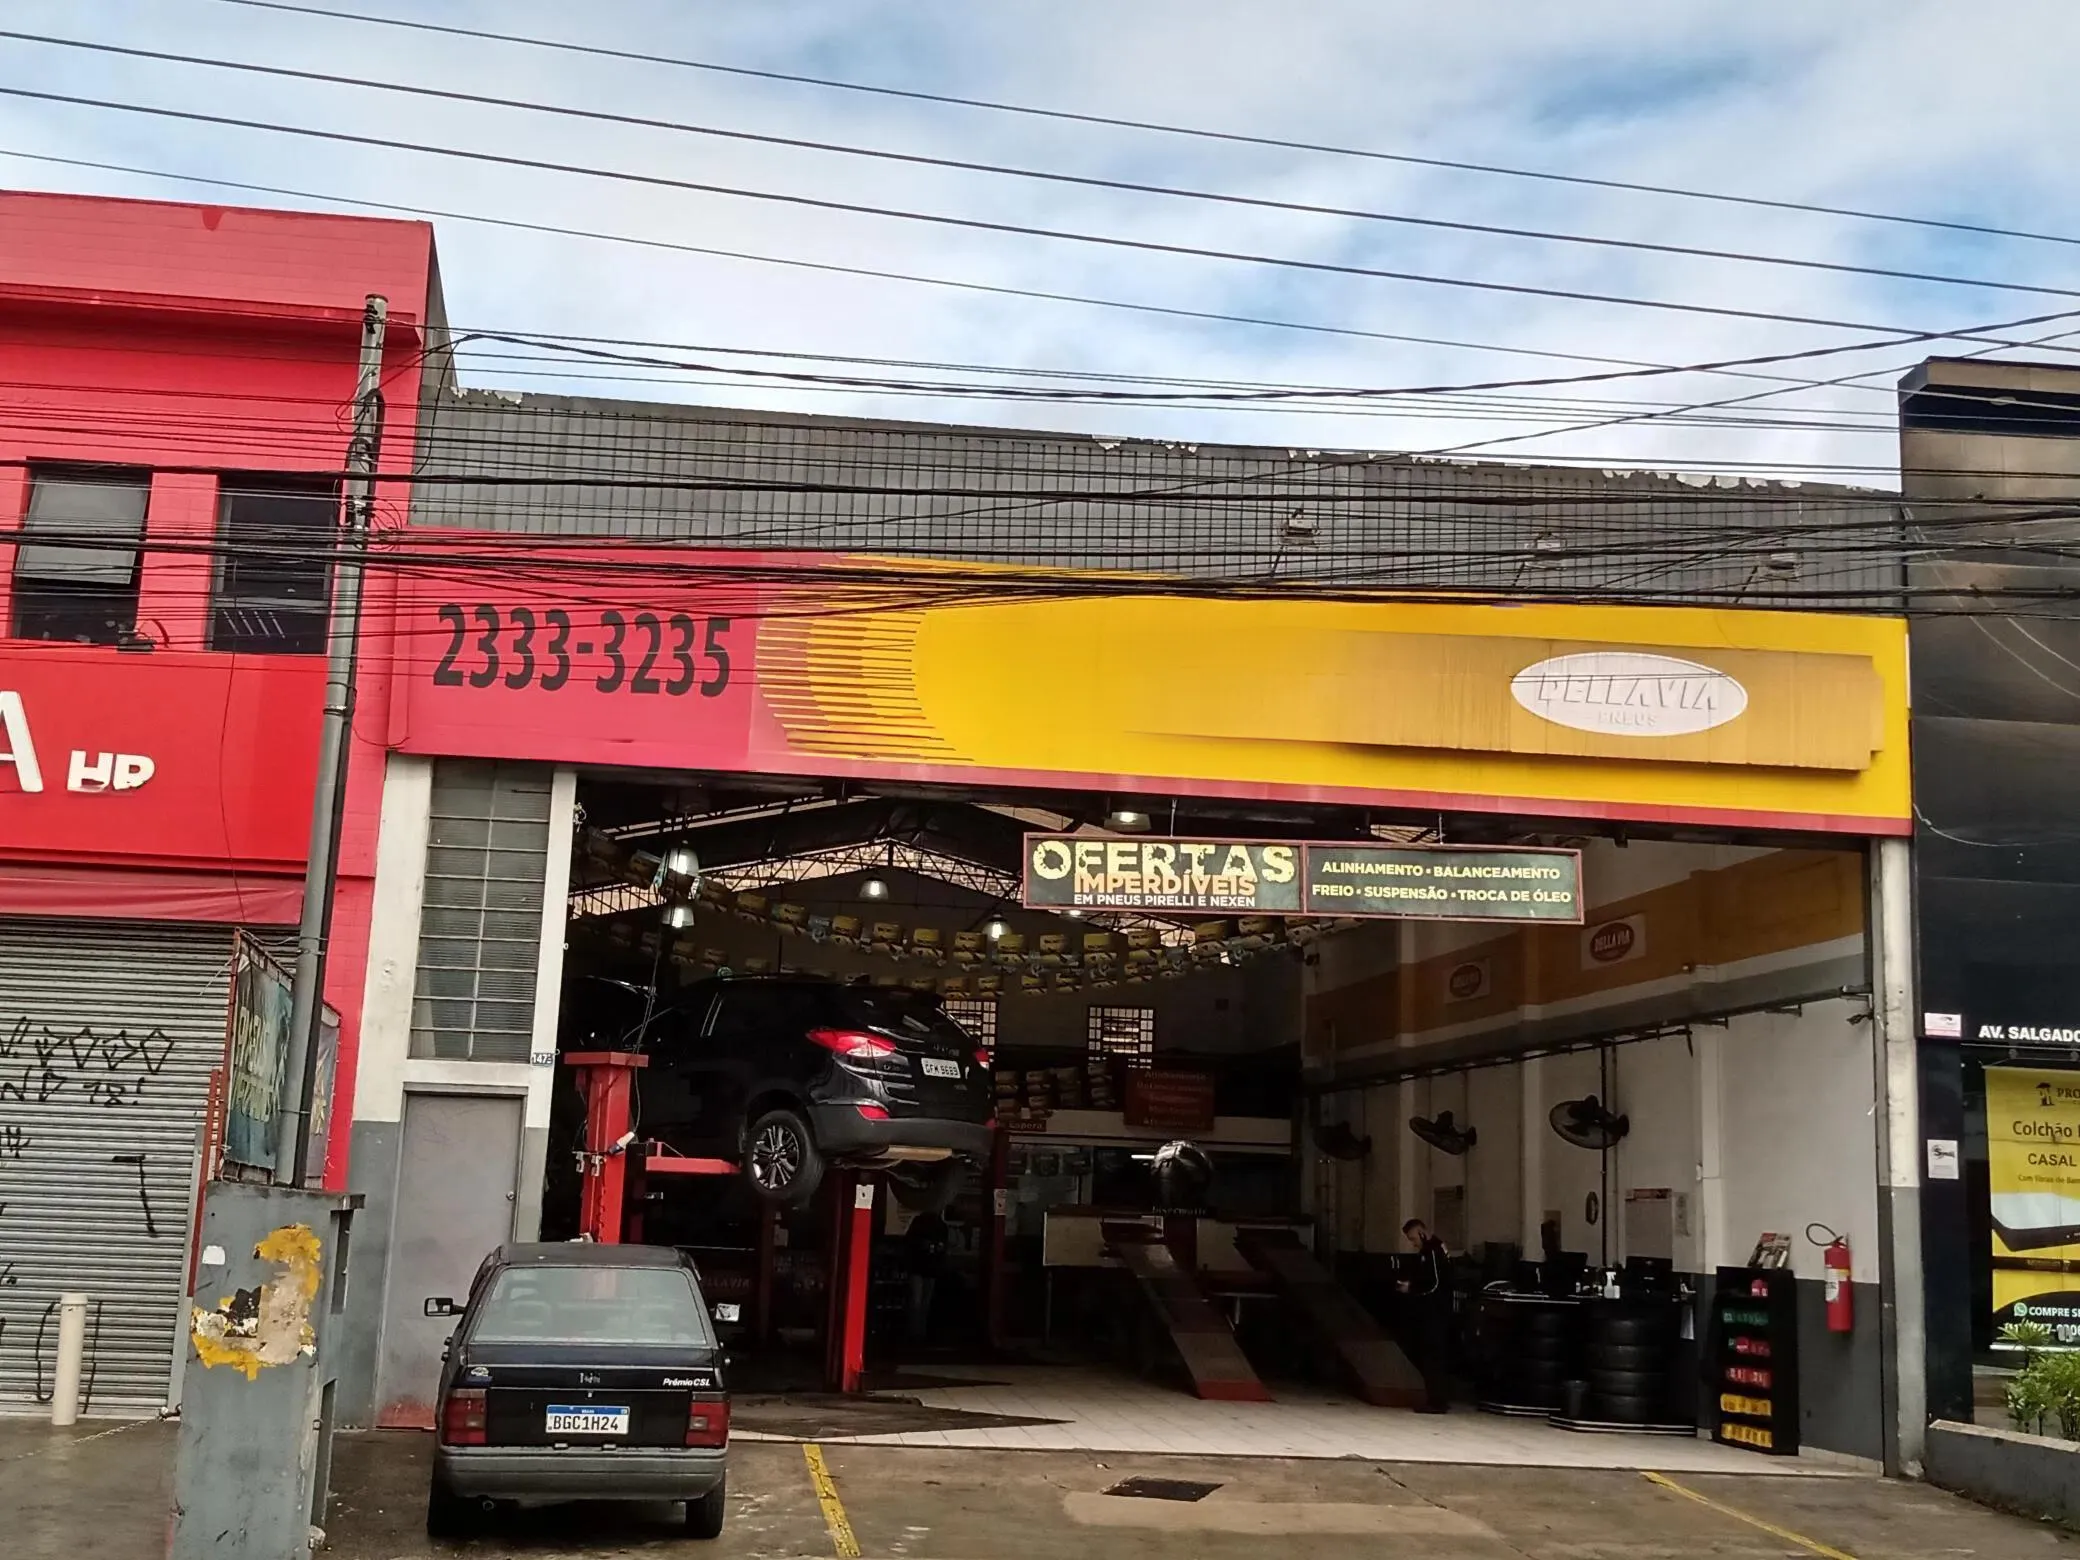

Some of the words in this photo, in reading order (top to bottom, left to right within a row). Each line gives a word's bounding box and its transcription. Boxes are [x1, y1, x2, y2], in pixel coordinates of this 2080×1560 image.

[433, 602, 731, 698] 2333-3235
[1032, 840, 1296, 884] OFERTAS
[1321, 862, 1423, 877] ALINHAMENTO
[1434, 866, 1560, 880] BALANCEAMENTO
[1073, 868, 1257, 896] IMPERDÍVEIS
[1074, 894, 1093, 905] EM
[1096, 894, 1141, 906] PNEUS
[1144, 895, 1194, 907] PIRELLI
[1198, 895, 1206, 907] E
[1210, 896, 1256, 908] NEXEN
[1312, 884, 1354, 897] FREIO
[1364, 885, 1448, 901] SUSPENSÃO
[1458, 889, 1507, 902] TROCA
[1511, 890, 1530, 902] DE
[1533, 888, 1572, 903] ÓLEO
[1978, 1025, 2005, 1039] AV.
[2012, 1120, 2073, 1138] Colchão
[2027, 1152, 2077, 1167] CASAL
[2028, 1306, 2070, 1317] COMPRE
[694, 1377, 711, 1387] CSL
[553, 1415, 619, 1431] BGC1H24
